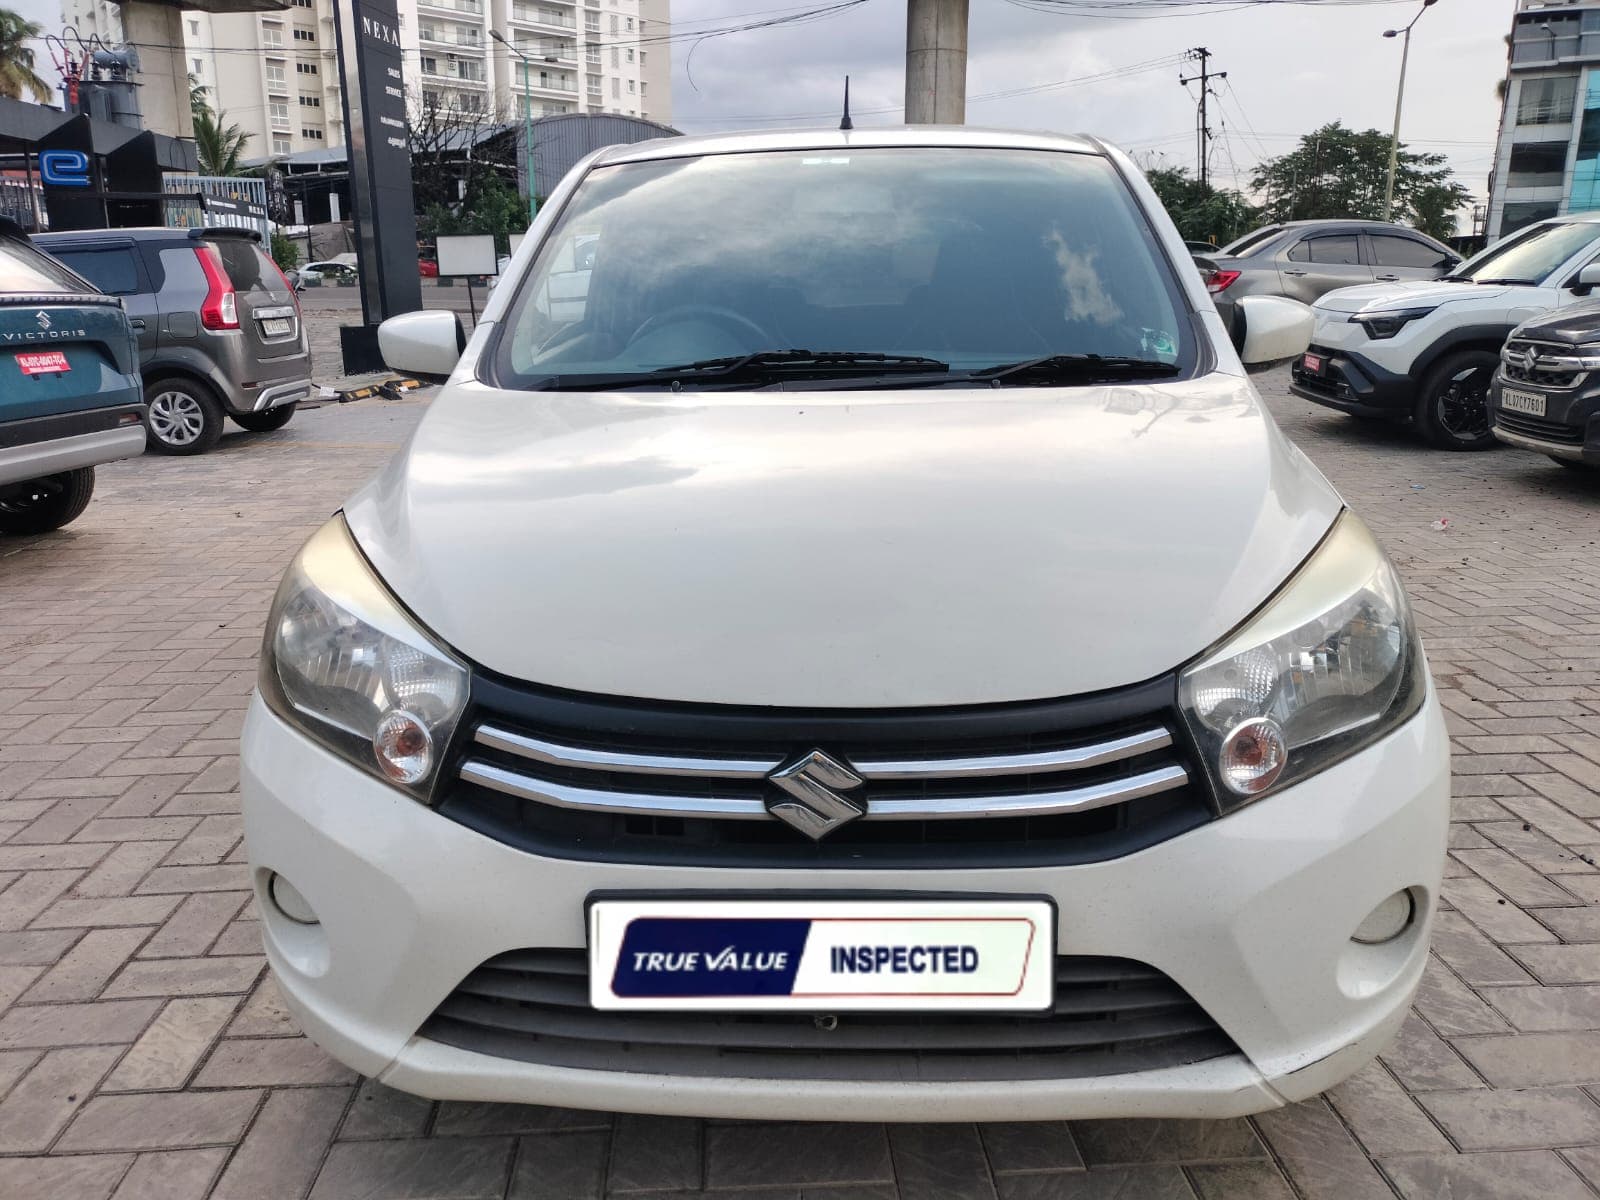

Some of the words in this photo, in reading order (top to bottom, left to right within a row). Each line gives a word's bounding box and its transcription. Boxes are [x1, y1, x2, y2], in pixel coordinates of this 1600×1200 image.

[363, 16, 399, 47] NEXA
[387, 67, 401, 78] SALES
[385, 86, 402, 97] SERVICE
[2, 329, 86, 340] VICTORIS
